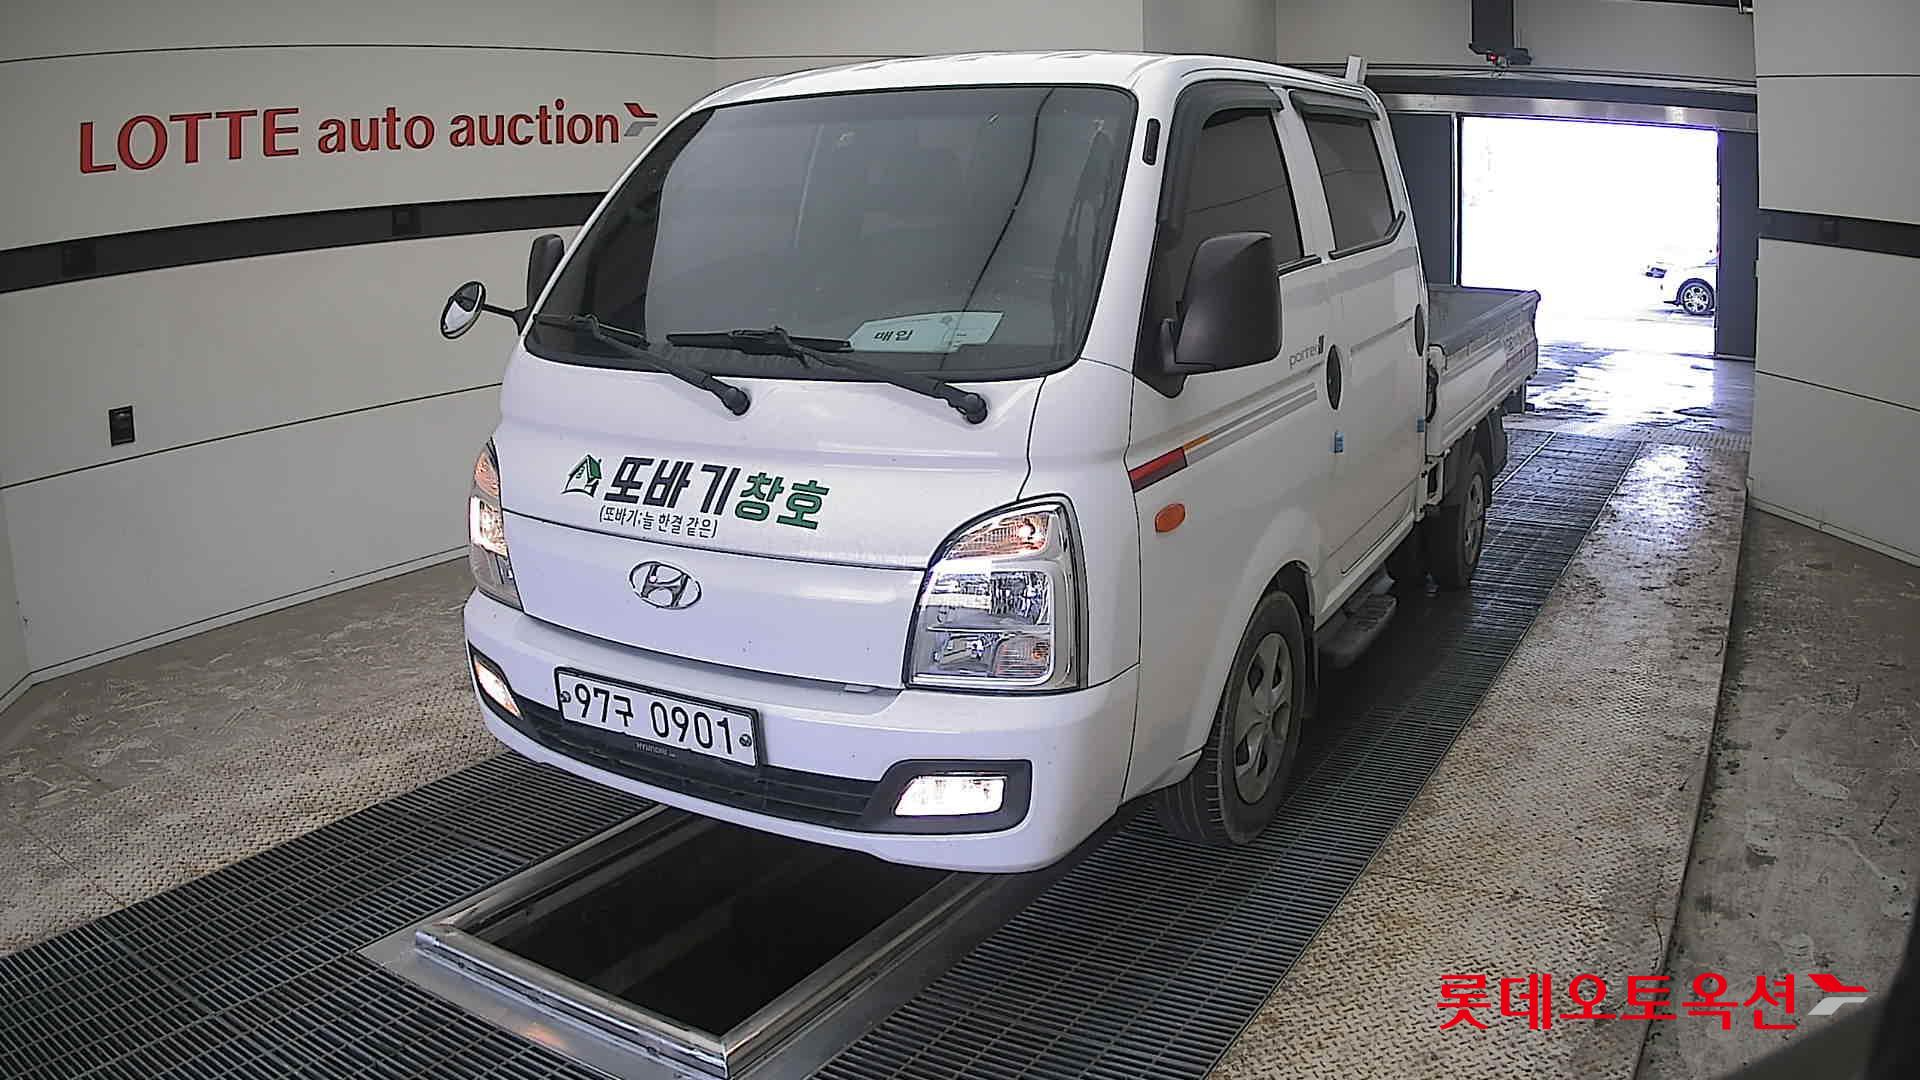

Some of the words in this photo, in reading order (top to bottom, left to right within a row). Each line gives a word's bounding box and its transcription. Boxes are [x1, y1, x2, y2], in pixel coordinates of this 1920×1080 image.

[79, 106, 300, 174] LOTTE
[316, 106, 435, 154] auto
[449, 98, 620, 147] auction
[874, 330, 913, 342] 매입
[658, 512, 683, 534] 한결
[687, 516, 719, 539] 같은)
[574, 683, 634, 727] 97구
[650, 701, 733, 754] 0901
